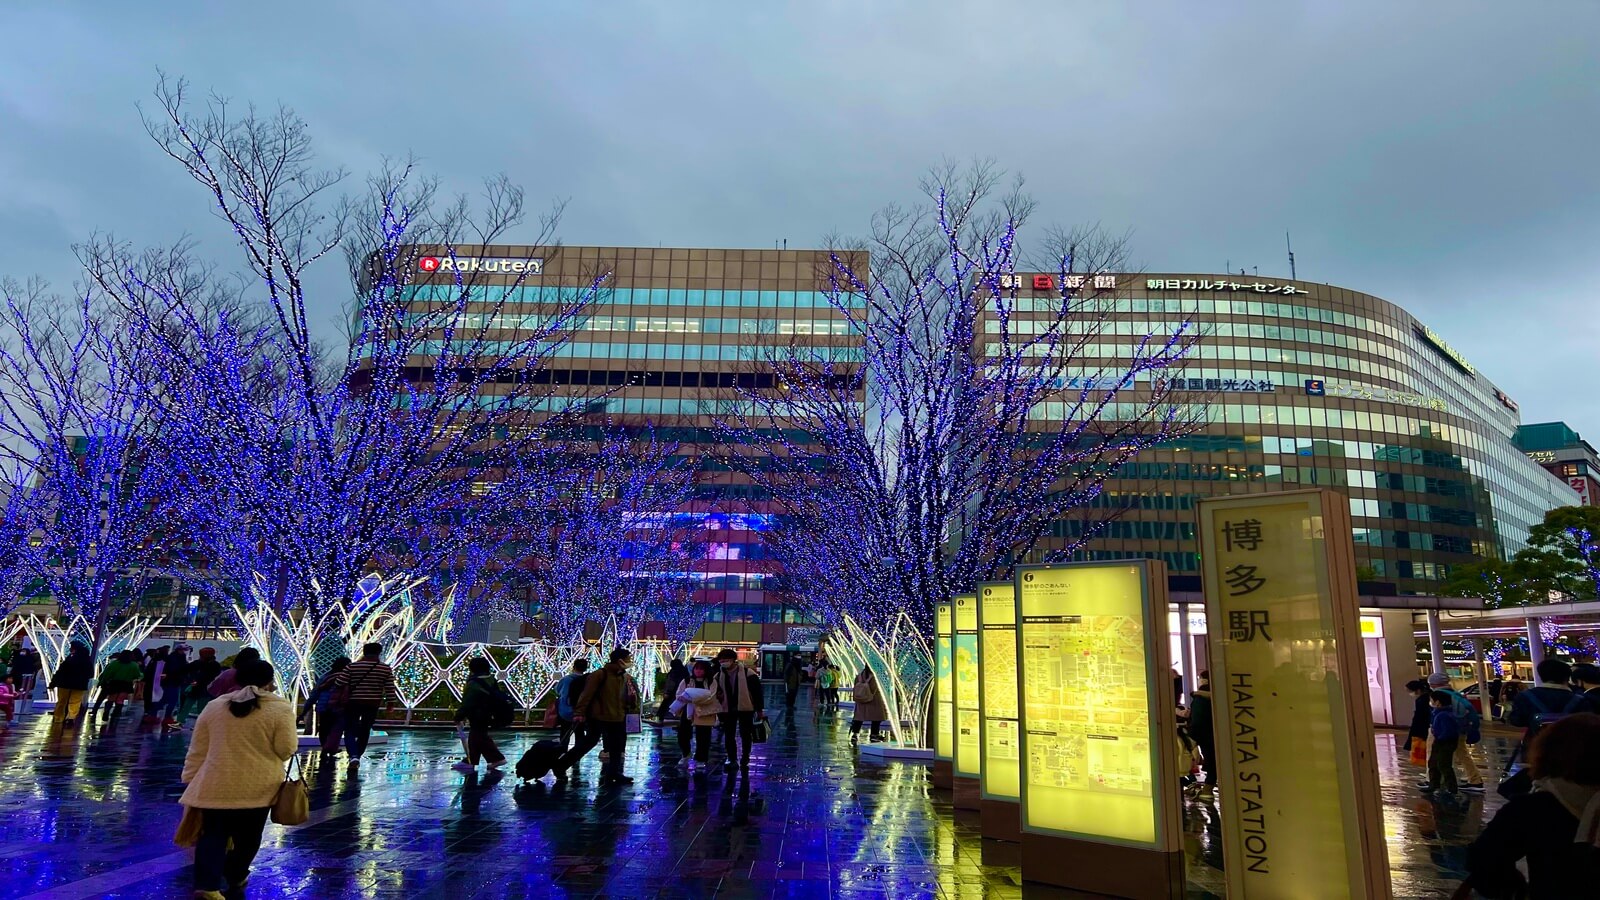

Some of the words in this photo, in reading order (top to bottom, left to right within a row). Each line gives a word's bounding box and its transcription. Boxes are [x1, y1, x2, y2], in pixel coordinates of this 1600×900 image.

[440, 257, 540, 273] Rakuten
[1146, 278, 1310, 295] 朝日カルチャーセンター
[1221, 518, 1273, 643] 博多駅
[1231, 673, 1259, 764] HAKATA
[1239, 771, 1269, 874] STATION
